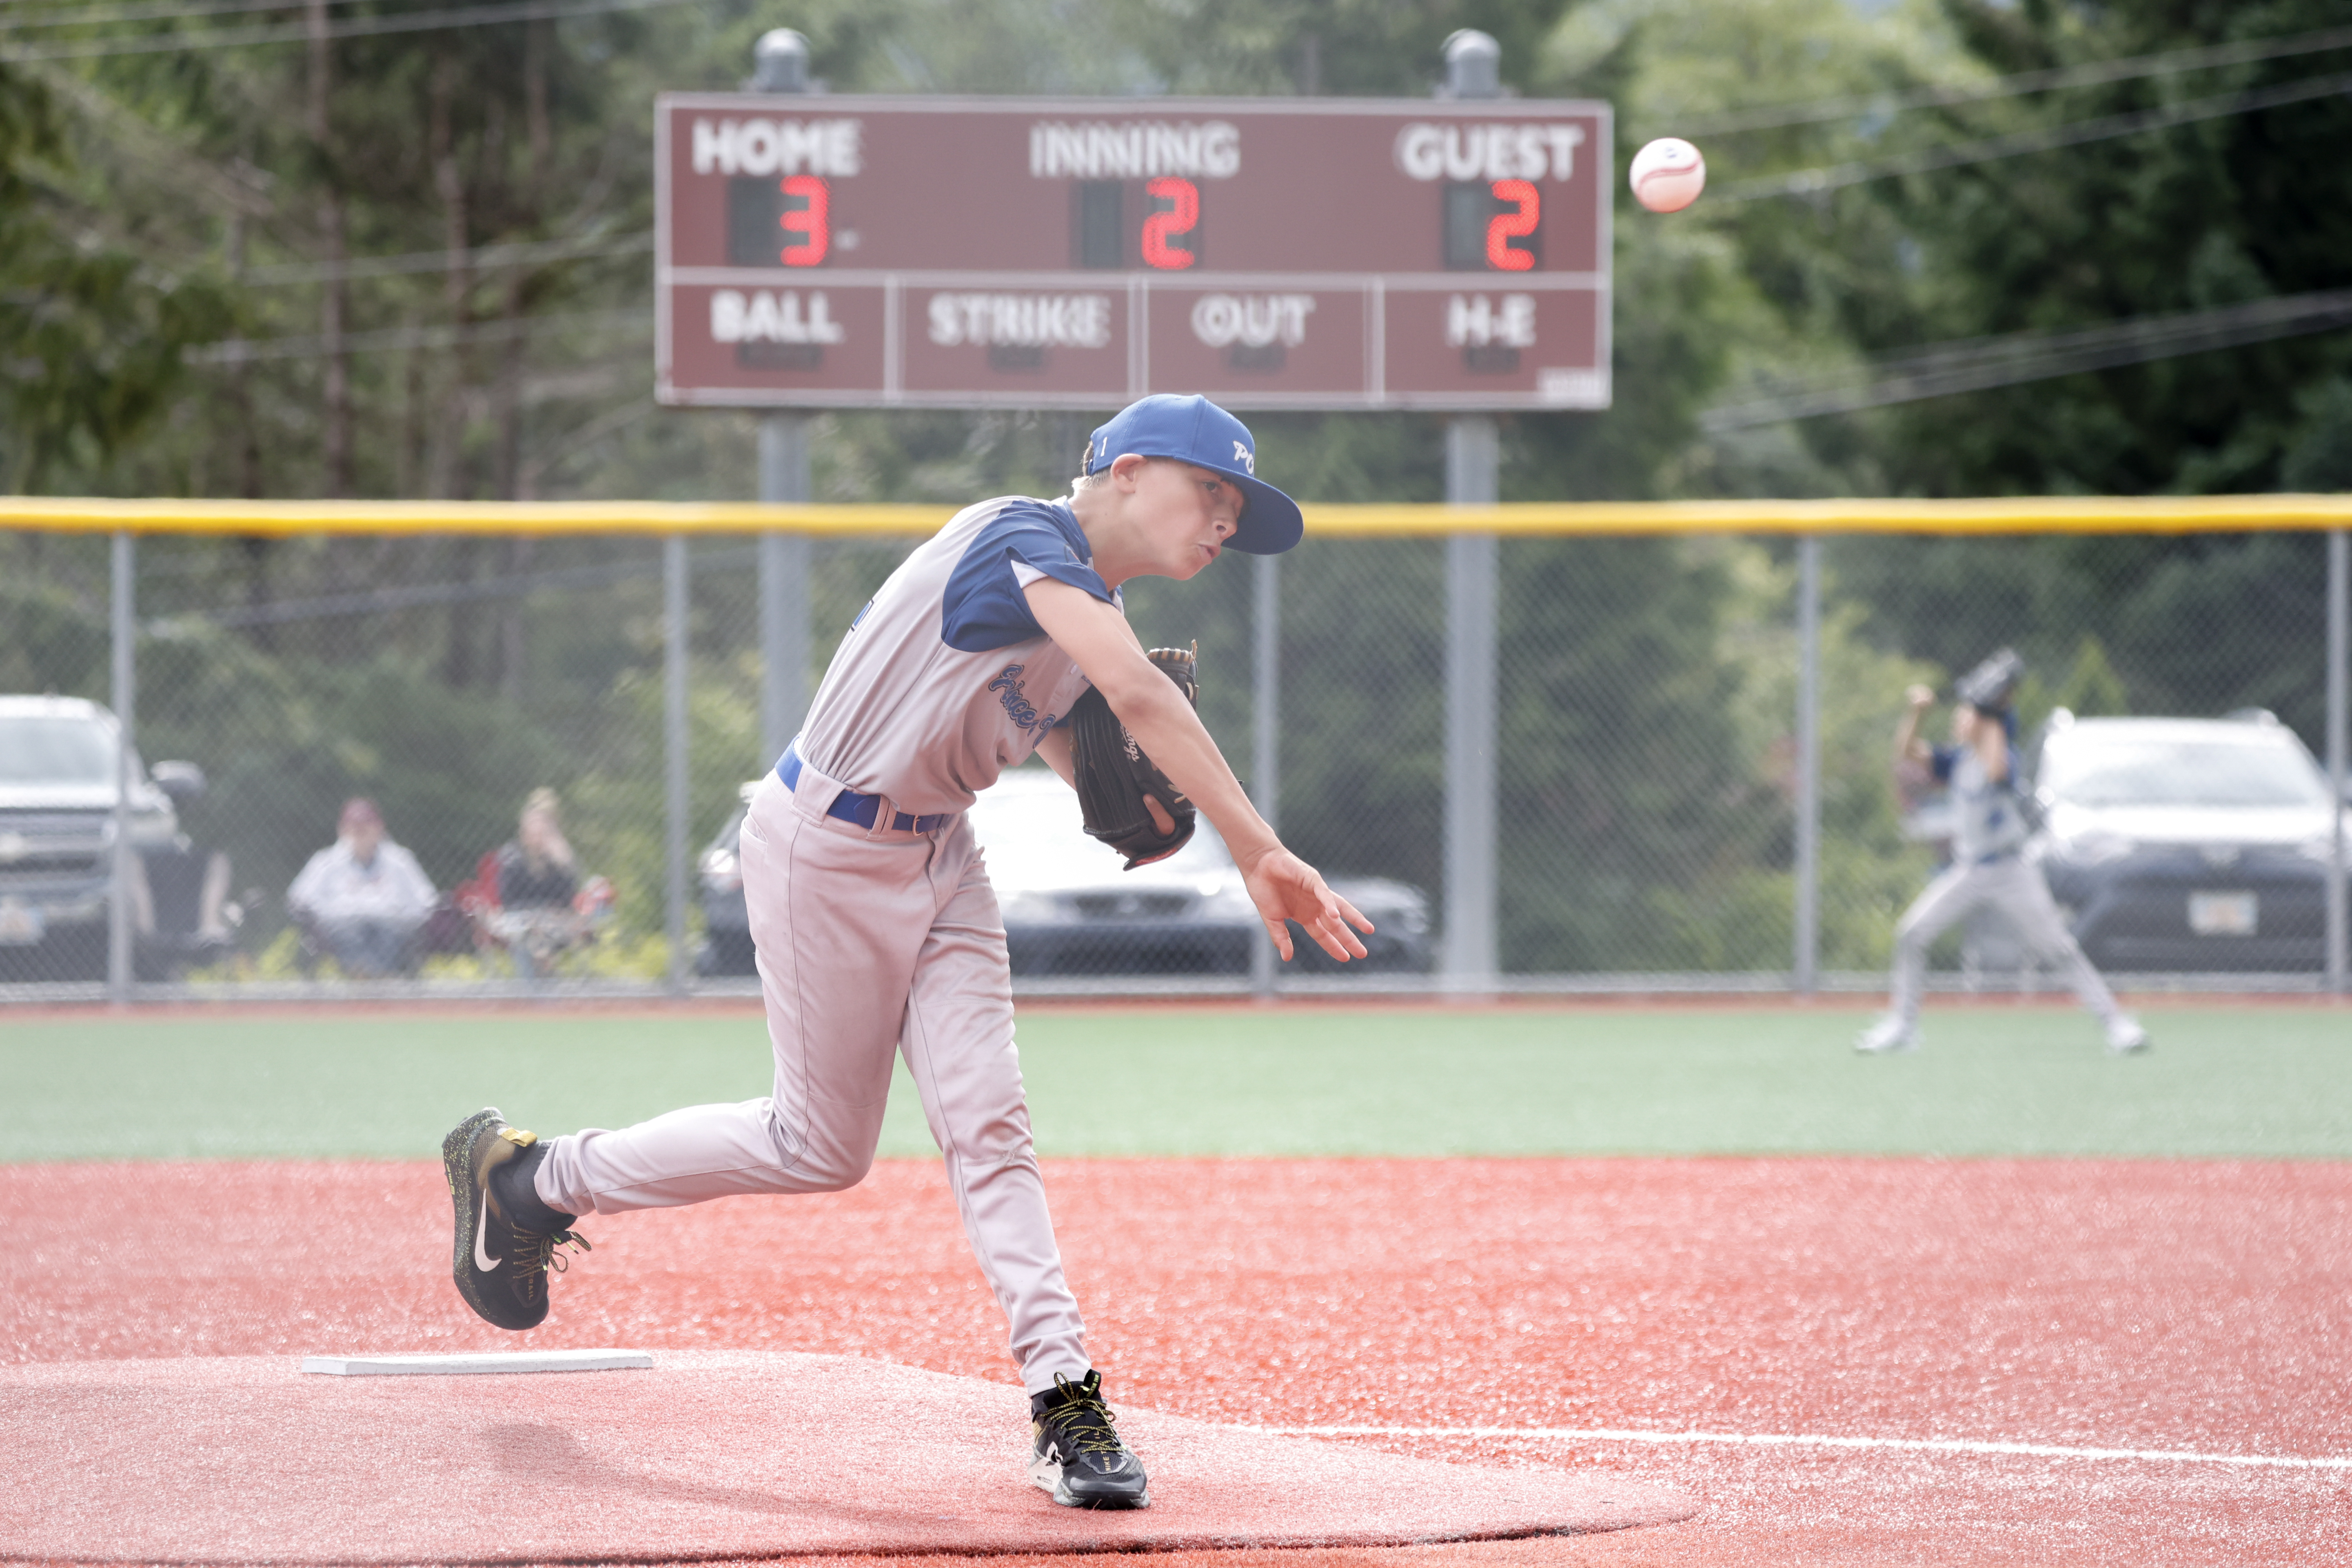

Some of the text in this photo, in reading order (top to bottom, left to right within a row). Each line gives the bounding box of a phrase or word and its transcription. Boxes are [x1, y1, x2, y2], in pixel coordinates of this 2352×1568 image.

[693, 120, 858, 175] HOME
[1030, 124, 1239, 177] INNING
[1400, 125, 1580, 180] GUEST
[782, 175, 828, 266] 3
[1143, 179, 1198, 268] 2
[1487, 180, 1540, 270] 2
[711, 291, 841, 343] BALL
[929, 294, 1108, 346] STRIKE
[1192, 294, 1313, 346] OUT
[1103, 1456, 1111, 1471] NIKE
